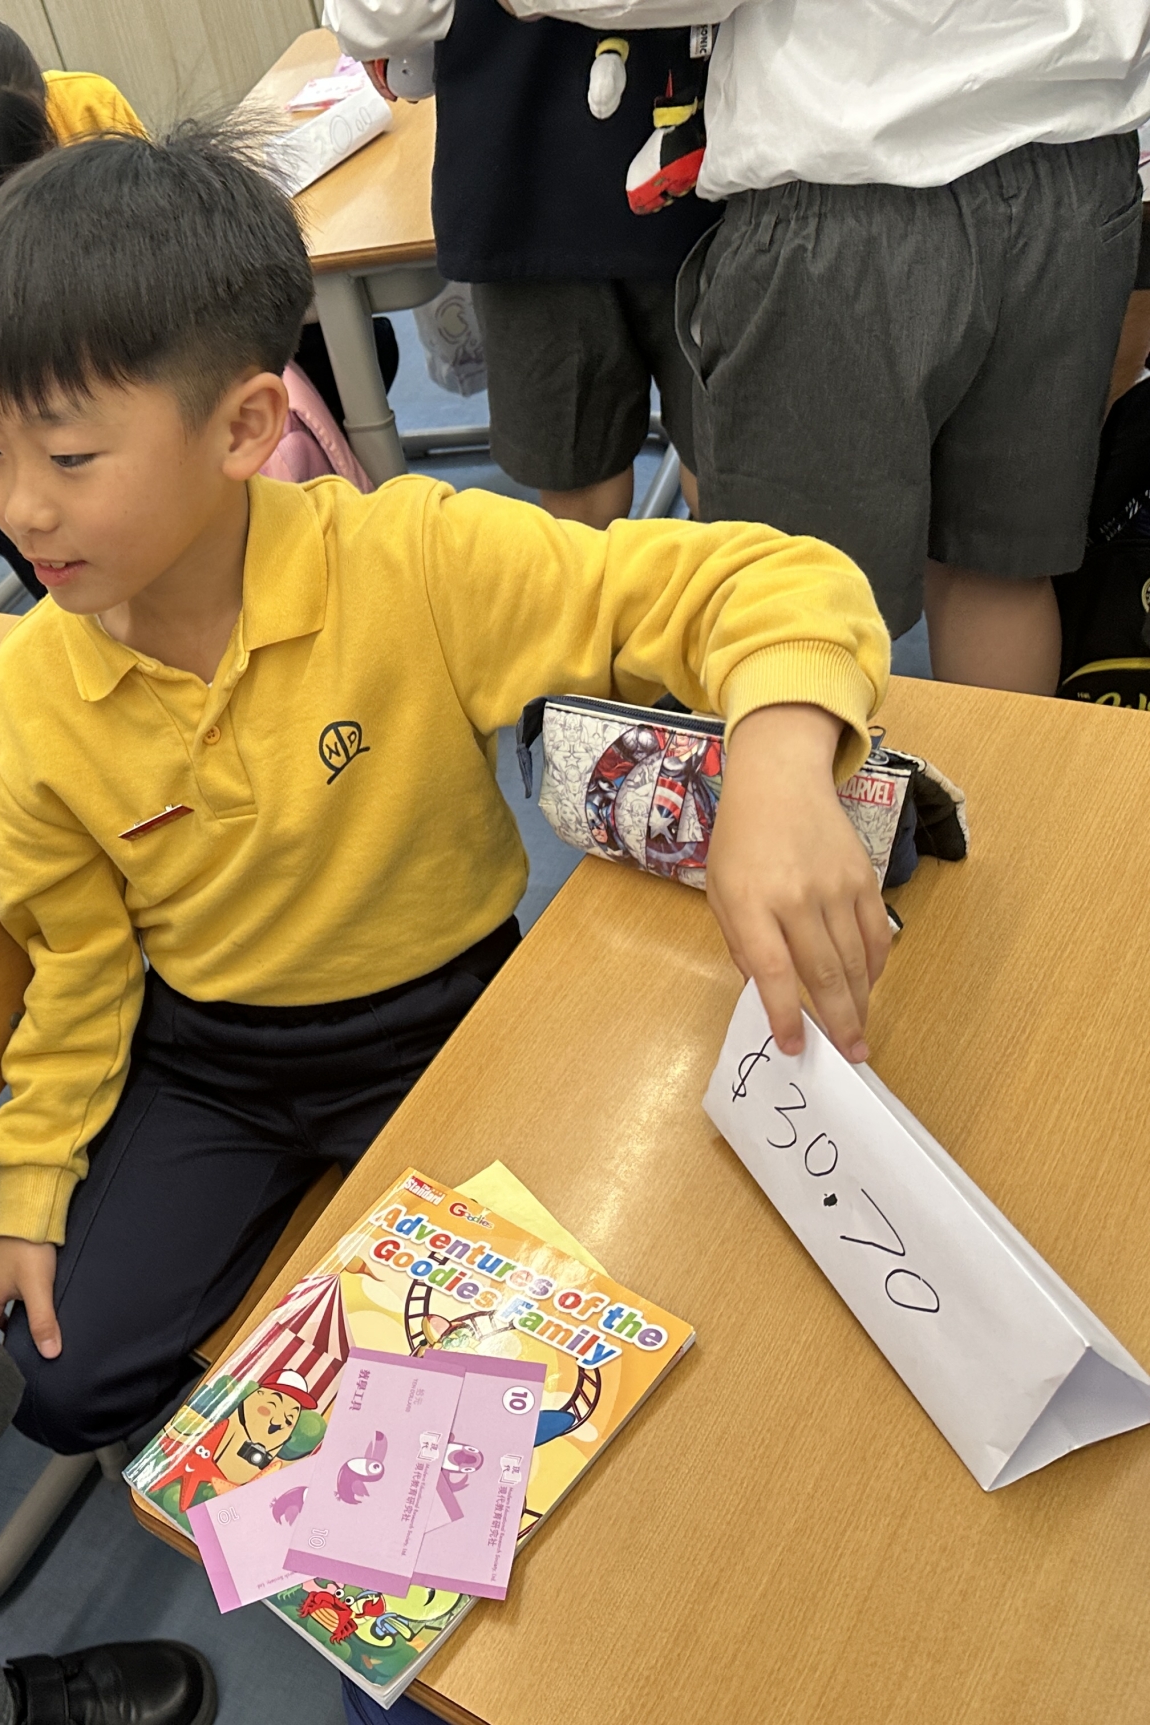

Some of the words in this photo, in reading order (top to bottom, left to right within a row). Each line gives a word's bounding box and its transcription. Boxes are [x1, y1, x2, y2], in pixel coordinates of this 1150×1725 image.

[404, 1178, 445, 1205] Standard
[732, 1034, 940, 1313] $30.70
[449, 1202, 493, 1229] Goodies
[371, 1207, 554, 1297] Adventures
[558, 1291, 602, 1318] of
[602, 1306, 664, 1347] the
[373, 1239, 499, 1308] Goodies
[500, 1298, 617, 1366] Family
[349, 1369, 371, 1411] 教學工具
[509, 1391, 528, 1410] 10
[401, 1462, 425, 1522] 現代教育研究社
[217, 1506, 240, 1525] 10
[487, 1486, 508, 1547] 現代教育研究社
[308, 1528, 329, 1549] 10
